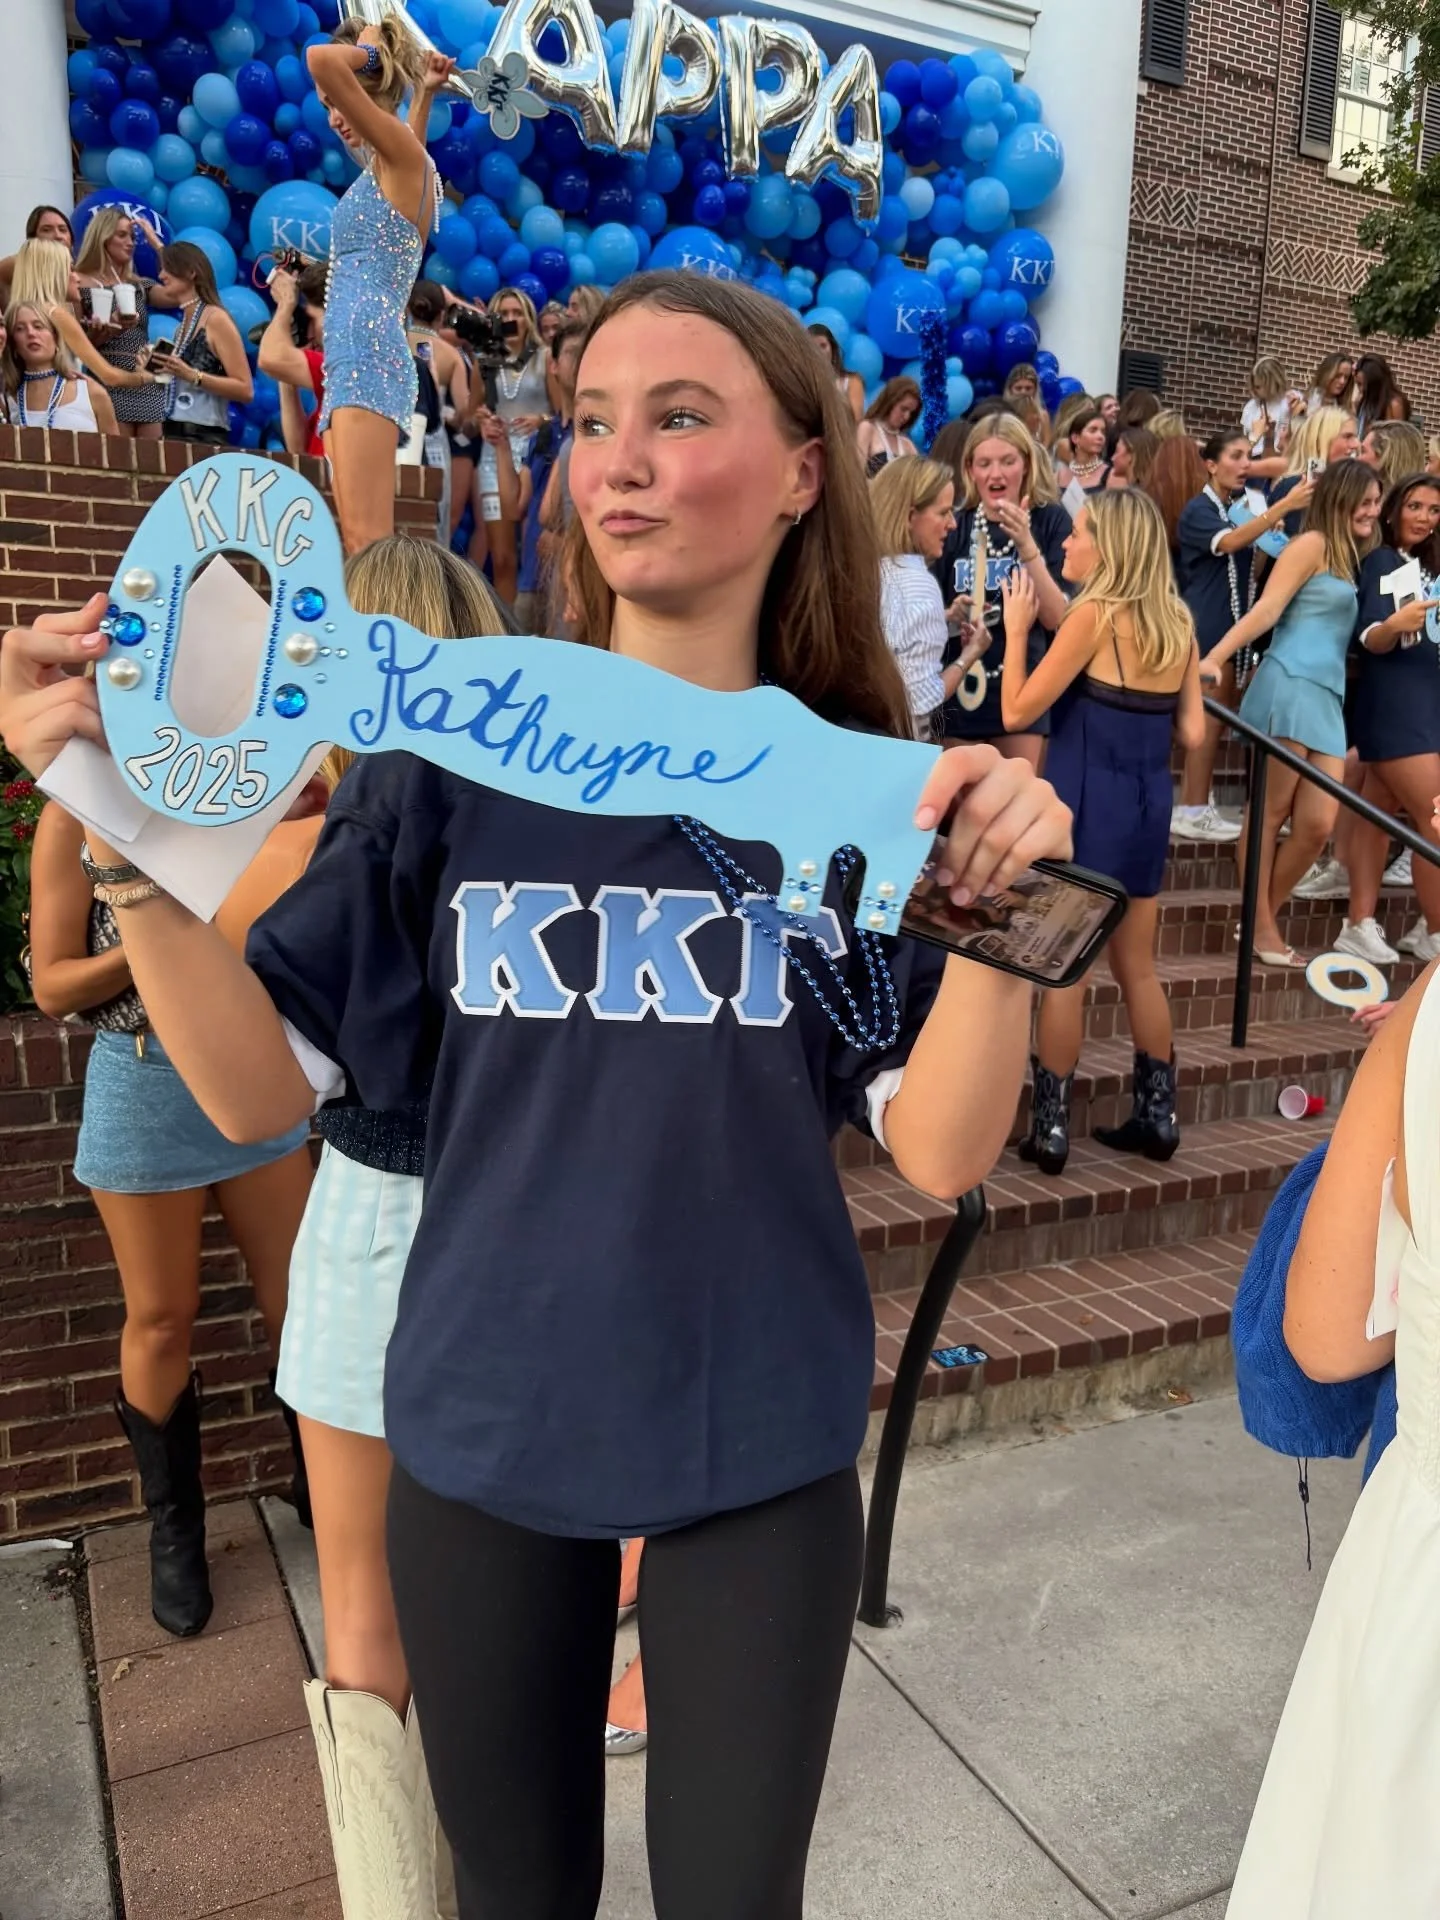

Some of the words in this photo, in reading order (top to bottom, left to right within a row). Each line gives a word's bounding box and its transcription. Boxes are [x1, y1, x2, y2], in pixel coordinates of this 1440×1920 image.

[179, 467, 313, 567] KKG
[350, 619, 774, 804] Kathryne
[124, 726, 269, 815] 2025
